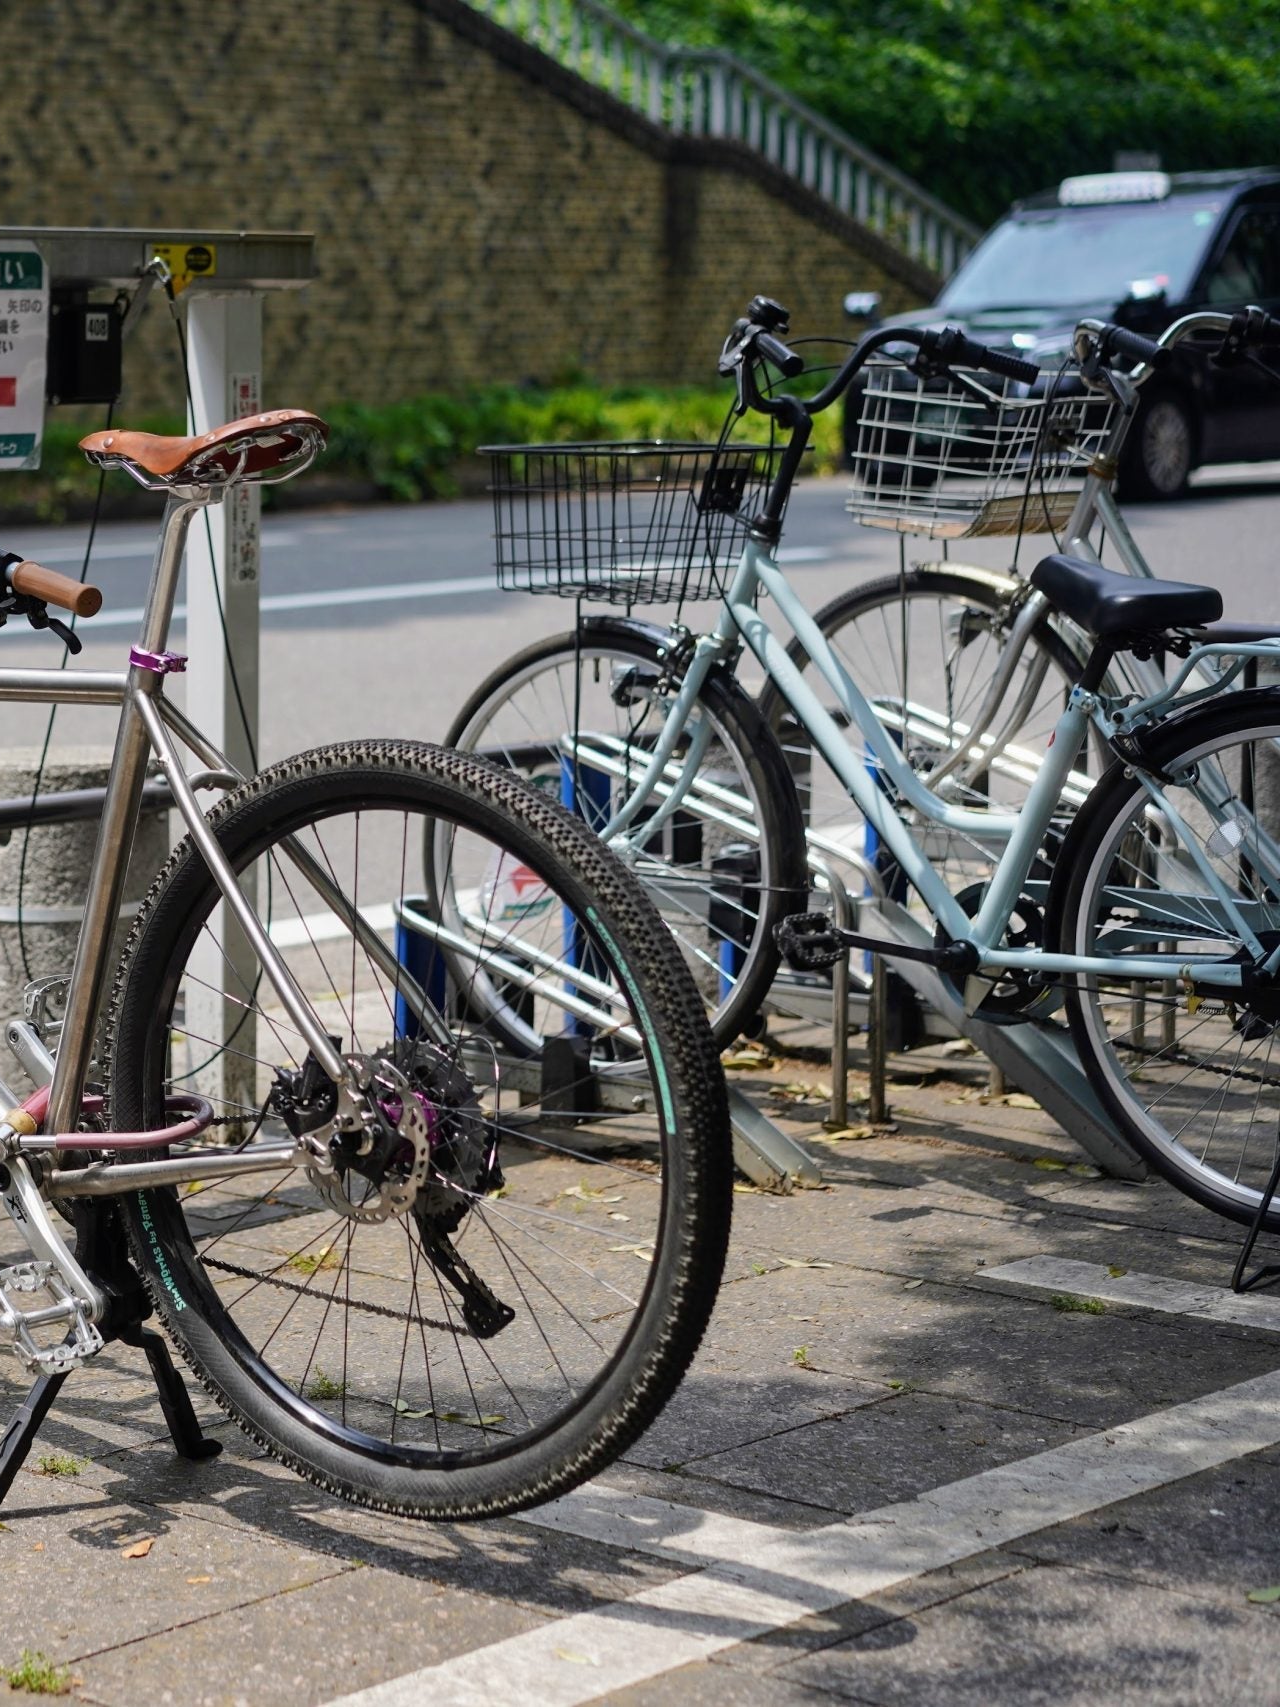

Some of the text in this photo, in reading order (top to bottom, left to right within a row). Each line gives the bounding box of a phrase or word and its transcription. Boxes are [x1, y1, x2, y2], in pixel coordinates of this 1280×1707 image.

[88, 318, 107, 337] 408
[6, 1195, 28, 1224] XT
[153, 1246, 187, 1312] SimWorks
